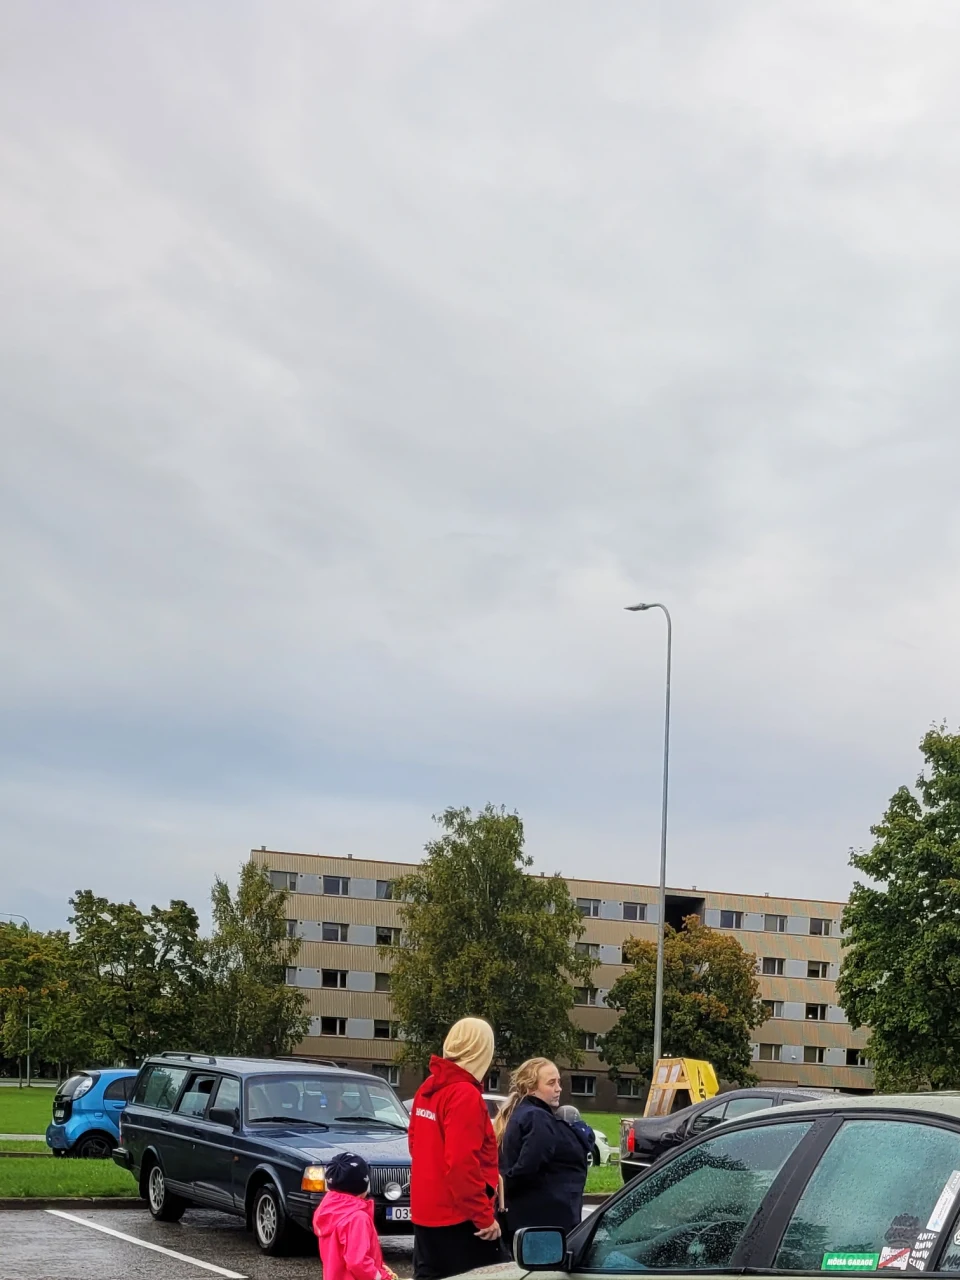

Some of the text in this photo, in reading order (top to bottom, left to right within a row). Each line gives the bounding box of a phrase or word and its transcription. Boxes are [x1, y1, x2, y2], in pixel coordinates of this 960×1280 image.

[395, 1208, 411, 1219] 03
[914, 1241, 933, 1249] BMW
[911, 1250, 929, 1259] BMW
[847, 1258, 874, 1266] GARAGE
[908, 1258, 925, 1271] CLUB
